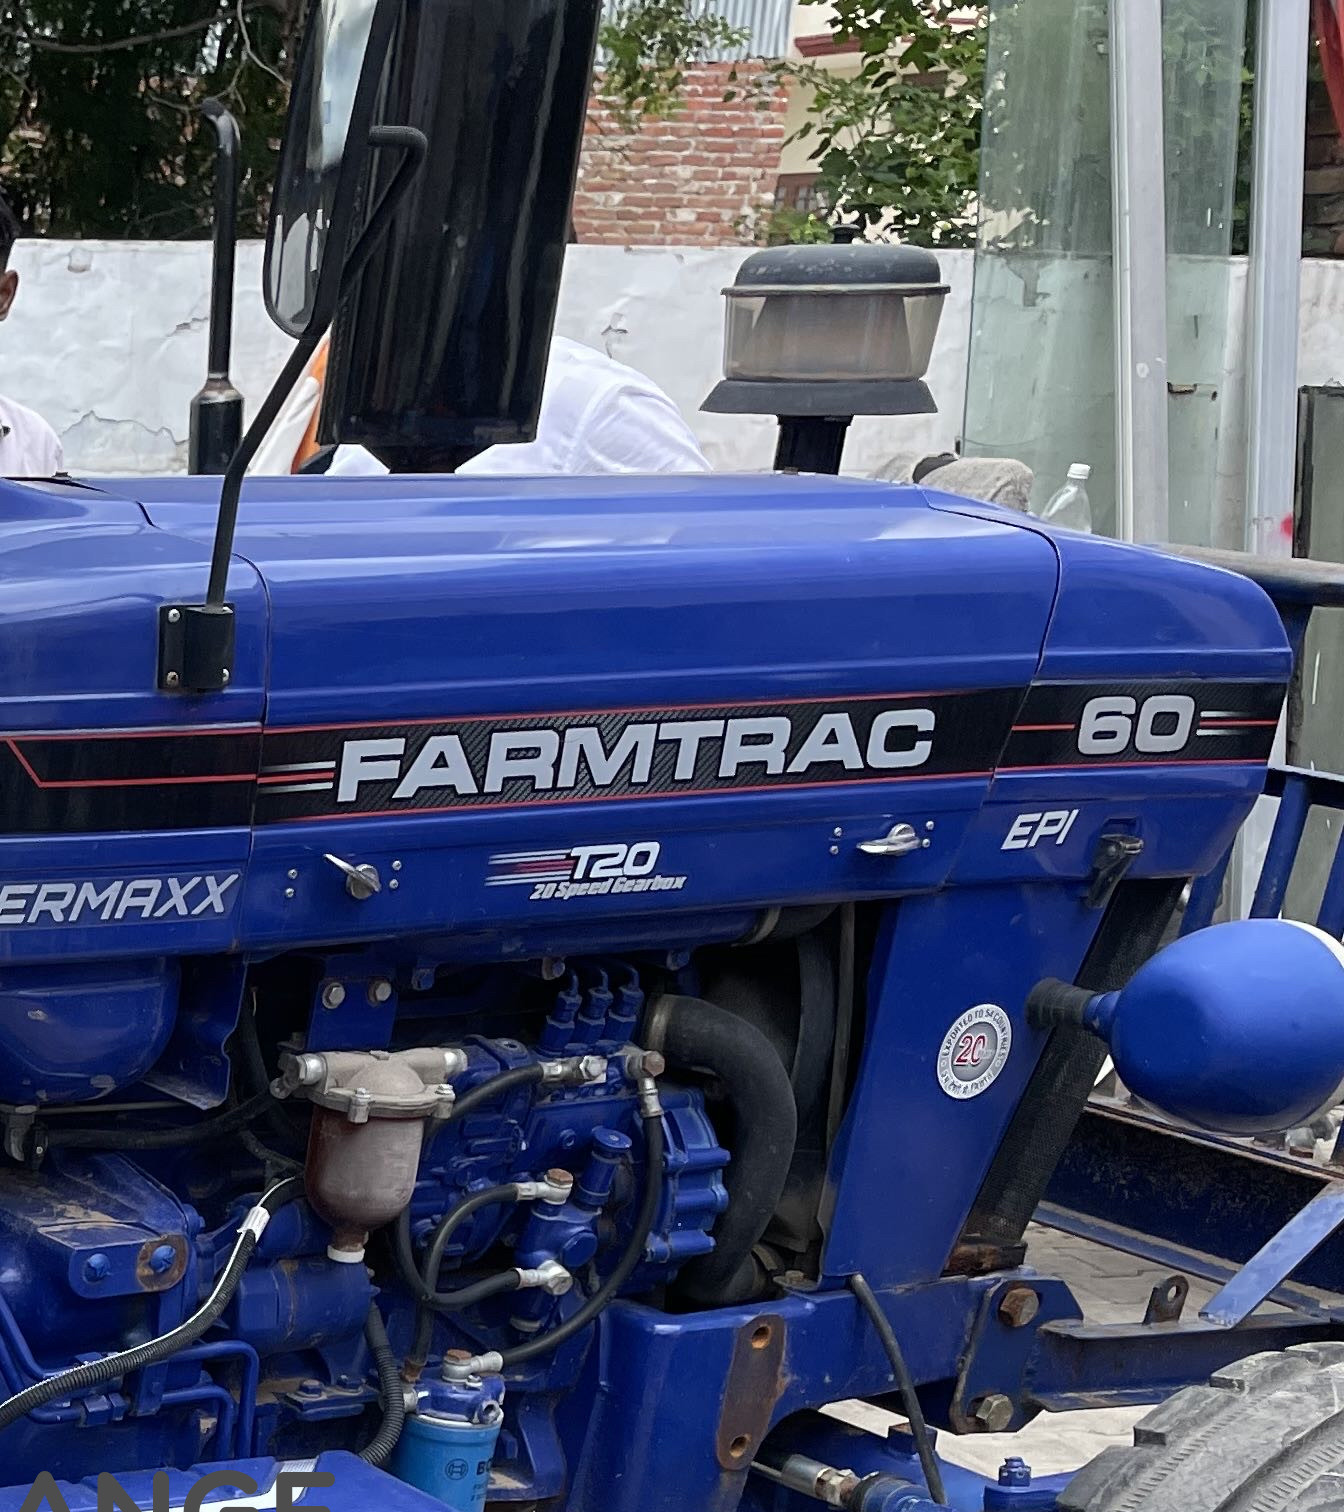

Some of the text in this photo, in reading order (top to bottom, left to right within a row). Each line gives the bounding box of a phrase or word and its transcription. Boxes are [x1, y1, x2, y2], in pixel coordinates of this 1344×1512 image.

[1076, 694, 1198, 756] 60
[336, 707, 938, 803] FARMTRAC
[1000, 808, 1076, 852] EPI
[570, 841, 661, 880] T20
[529, 874, 687, 900] 20 Speed Gearbox
